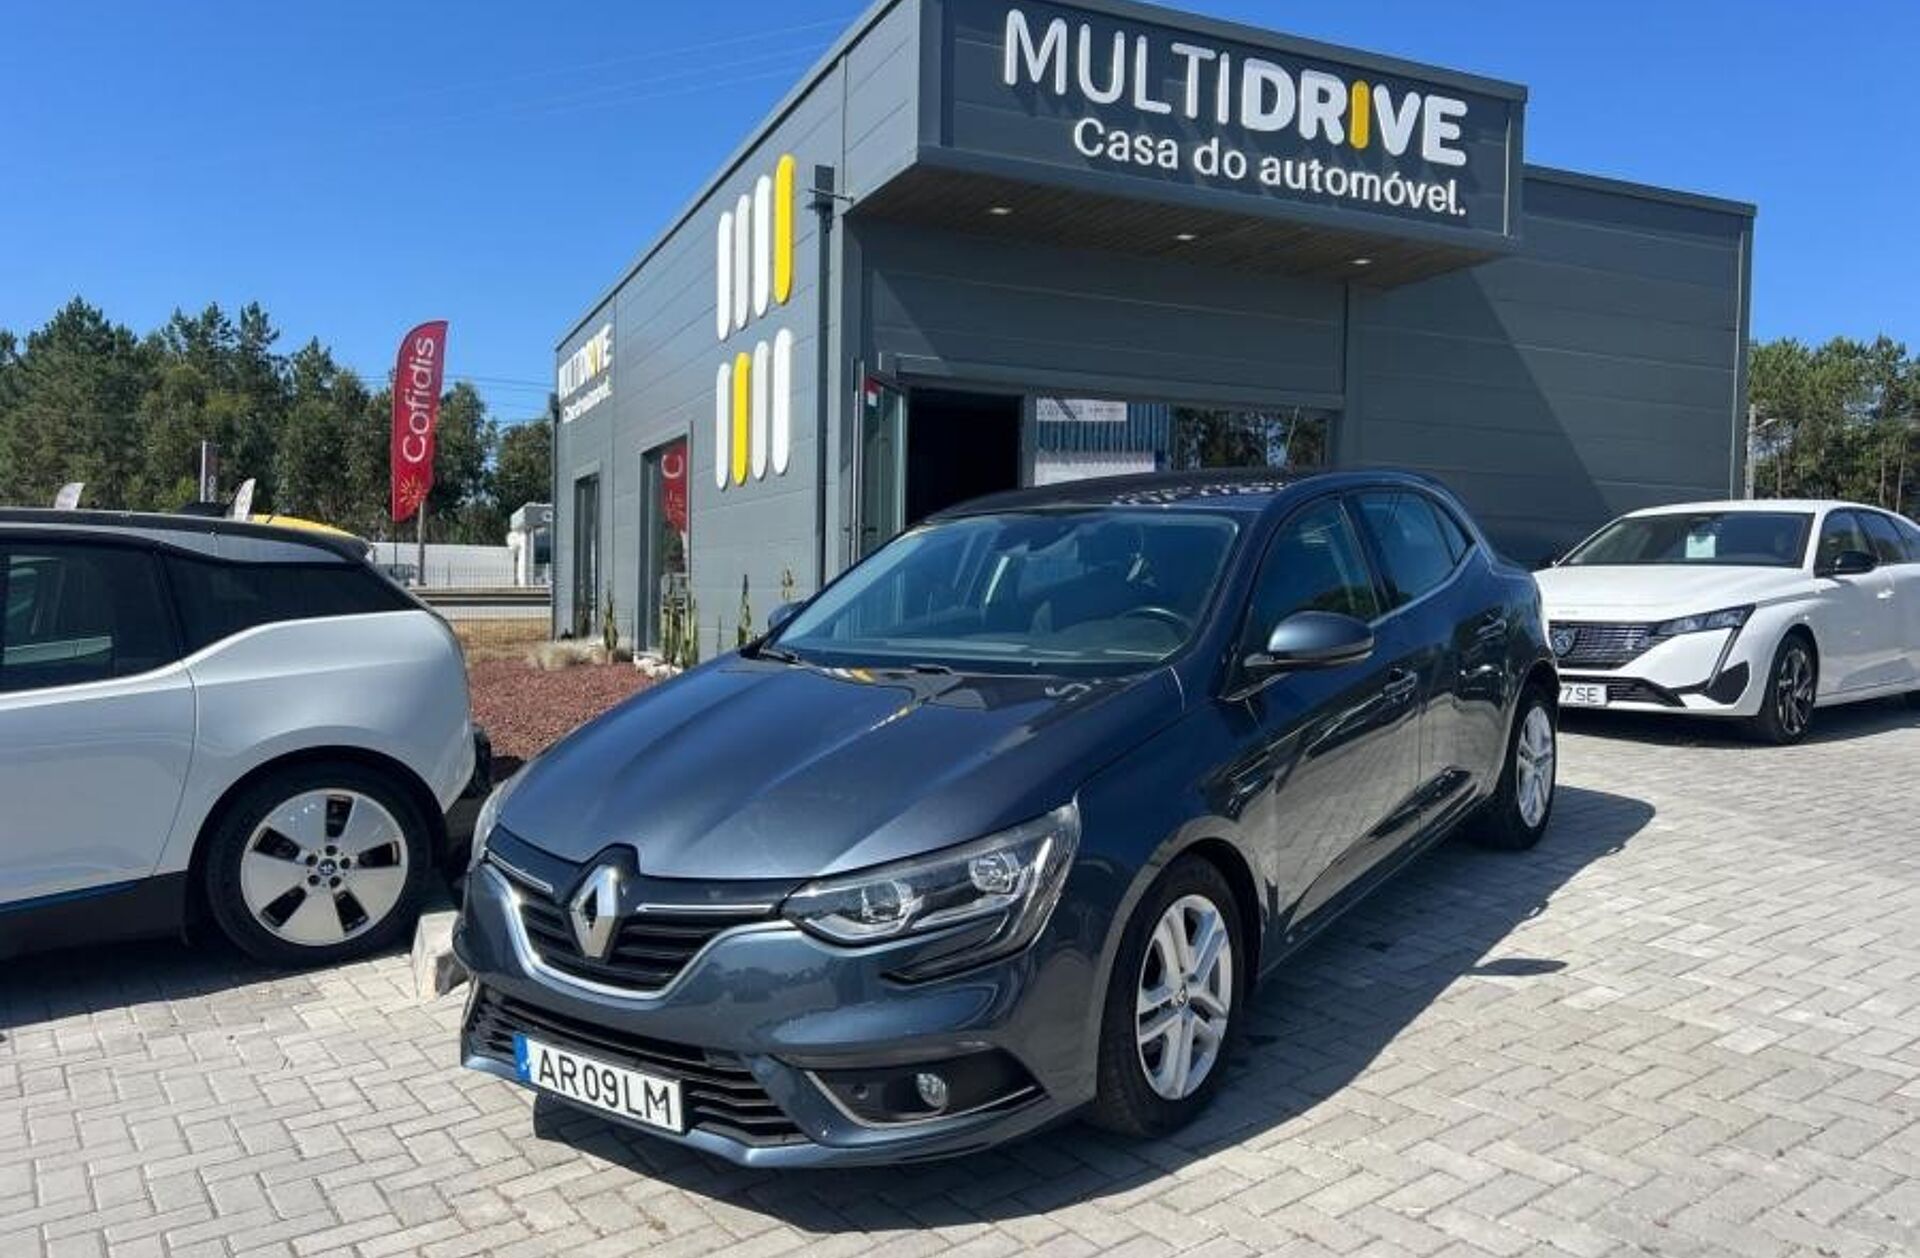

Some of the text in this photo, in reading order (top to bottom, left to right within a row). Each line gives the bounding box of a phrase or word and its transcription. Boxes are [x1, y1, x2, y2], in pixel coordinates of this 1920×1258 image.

[1004, 9, 1468, 167] MULTIDRIVE
[1073, 117, 1467, 217] Casa do automóvel.
[402, 337, 434, 463] Cofidis
